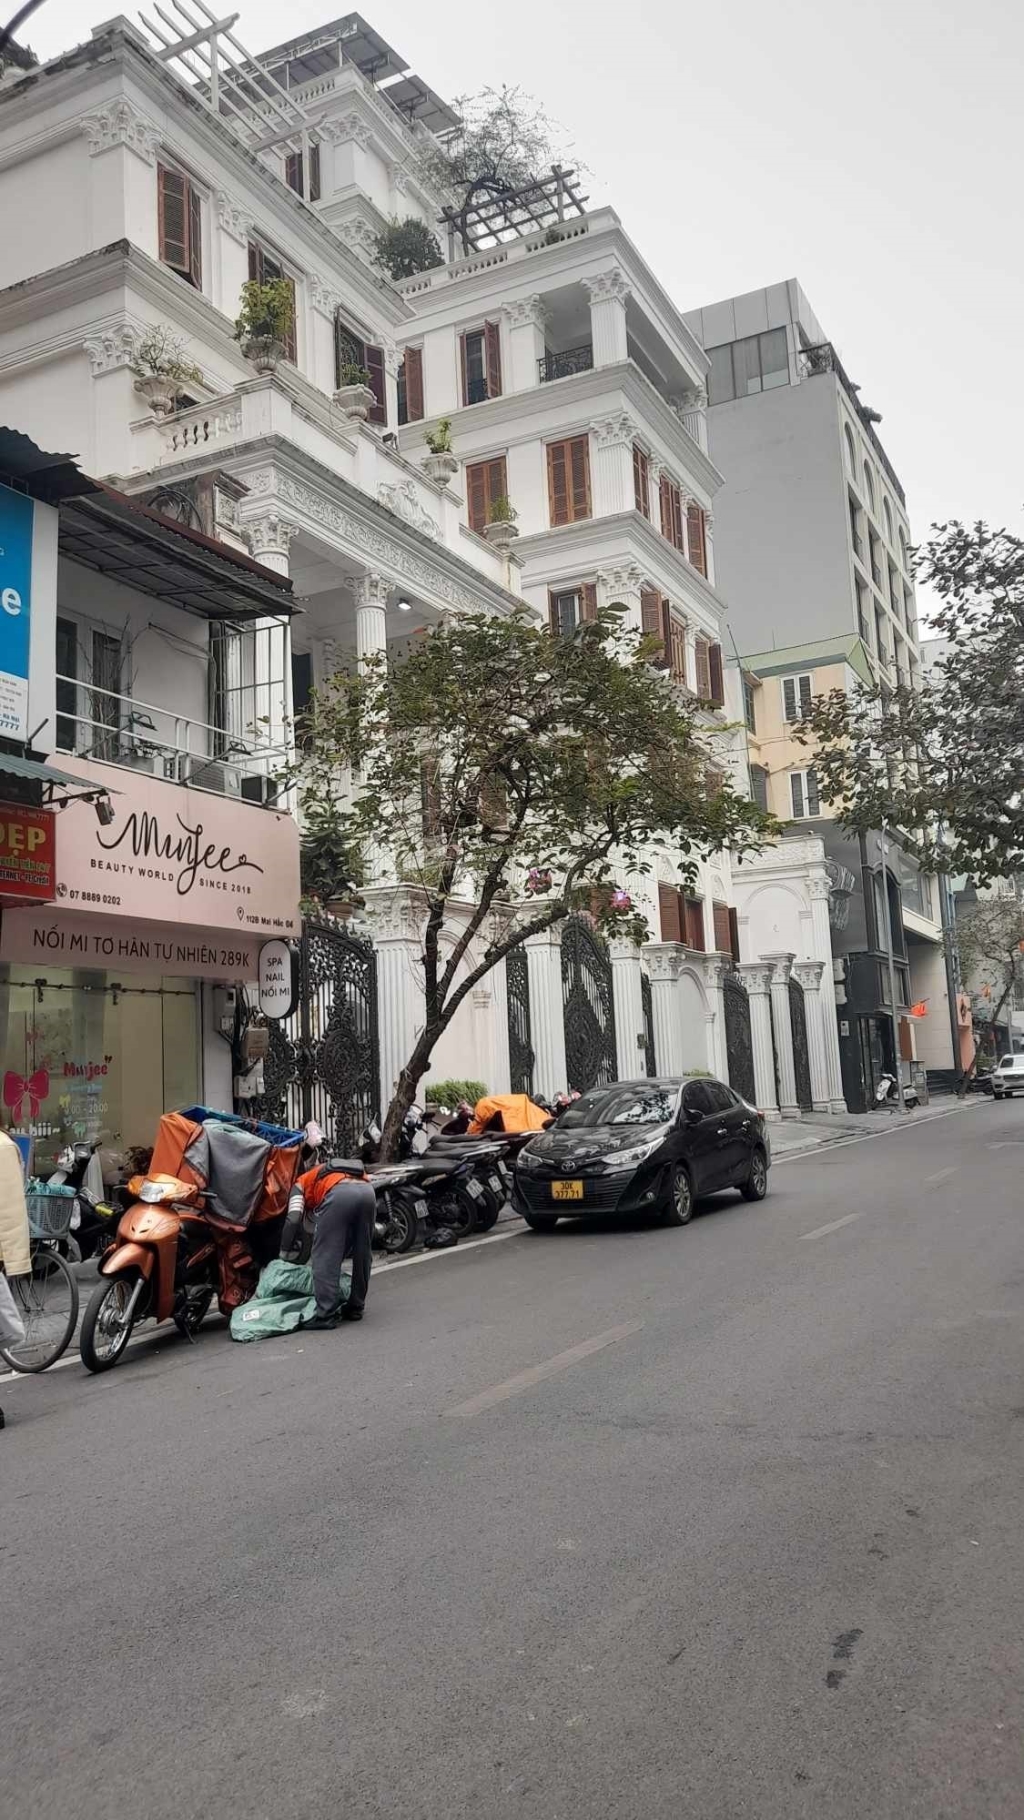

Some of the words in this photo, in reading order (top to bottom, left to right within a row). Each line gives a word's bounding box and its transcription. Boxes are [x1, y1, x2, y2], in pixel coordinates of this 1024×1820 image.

[90, 858, 134, 875] BEAUTY
[138, 867, 174, 882] WORLD
[200, 877, 228, 891] SINCE
[231, 883, 251, 895] 2018
[69, 889, 80, 900] 07
[102, 894, 121, 906] 0202
[33, 924, 65, 949] NỐI
[69, 933, 88, 953] MI
[93, 936, 114, 955] TƠ
[154, 942, 174, 964] TỰ
[177, 944, 217, 964] NHIÊN
[220, 949, 250, 968] 289K
[267, 957, 283, 967] SPA
[265, 972, 285, 982] NAIL
[279, 987, 290, 997] MI
